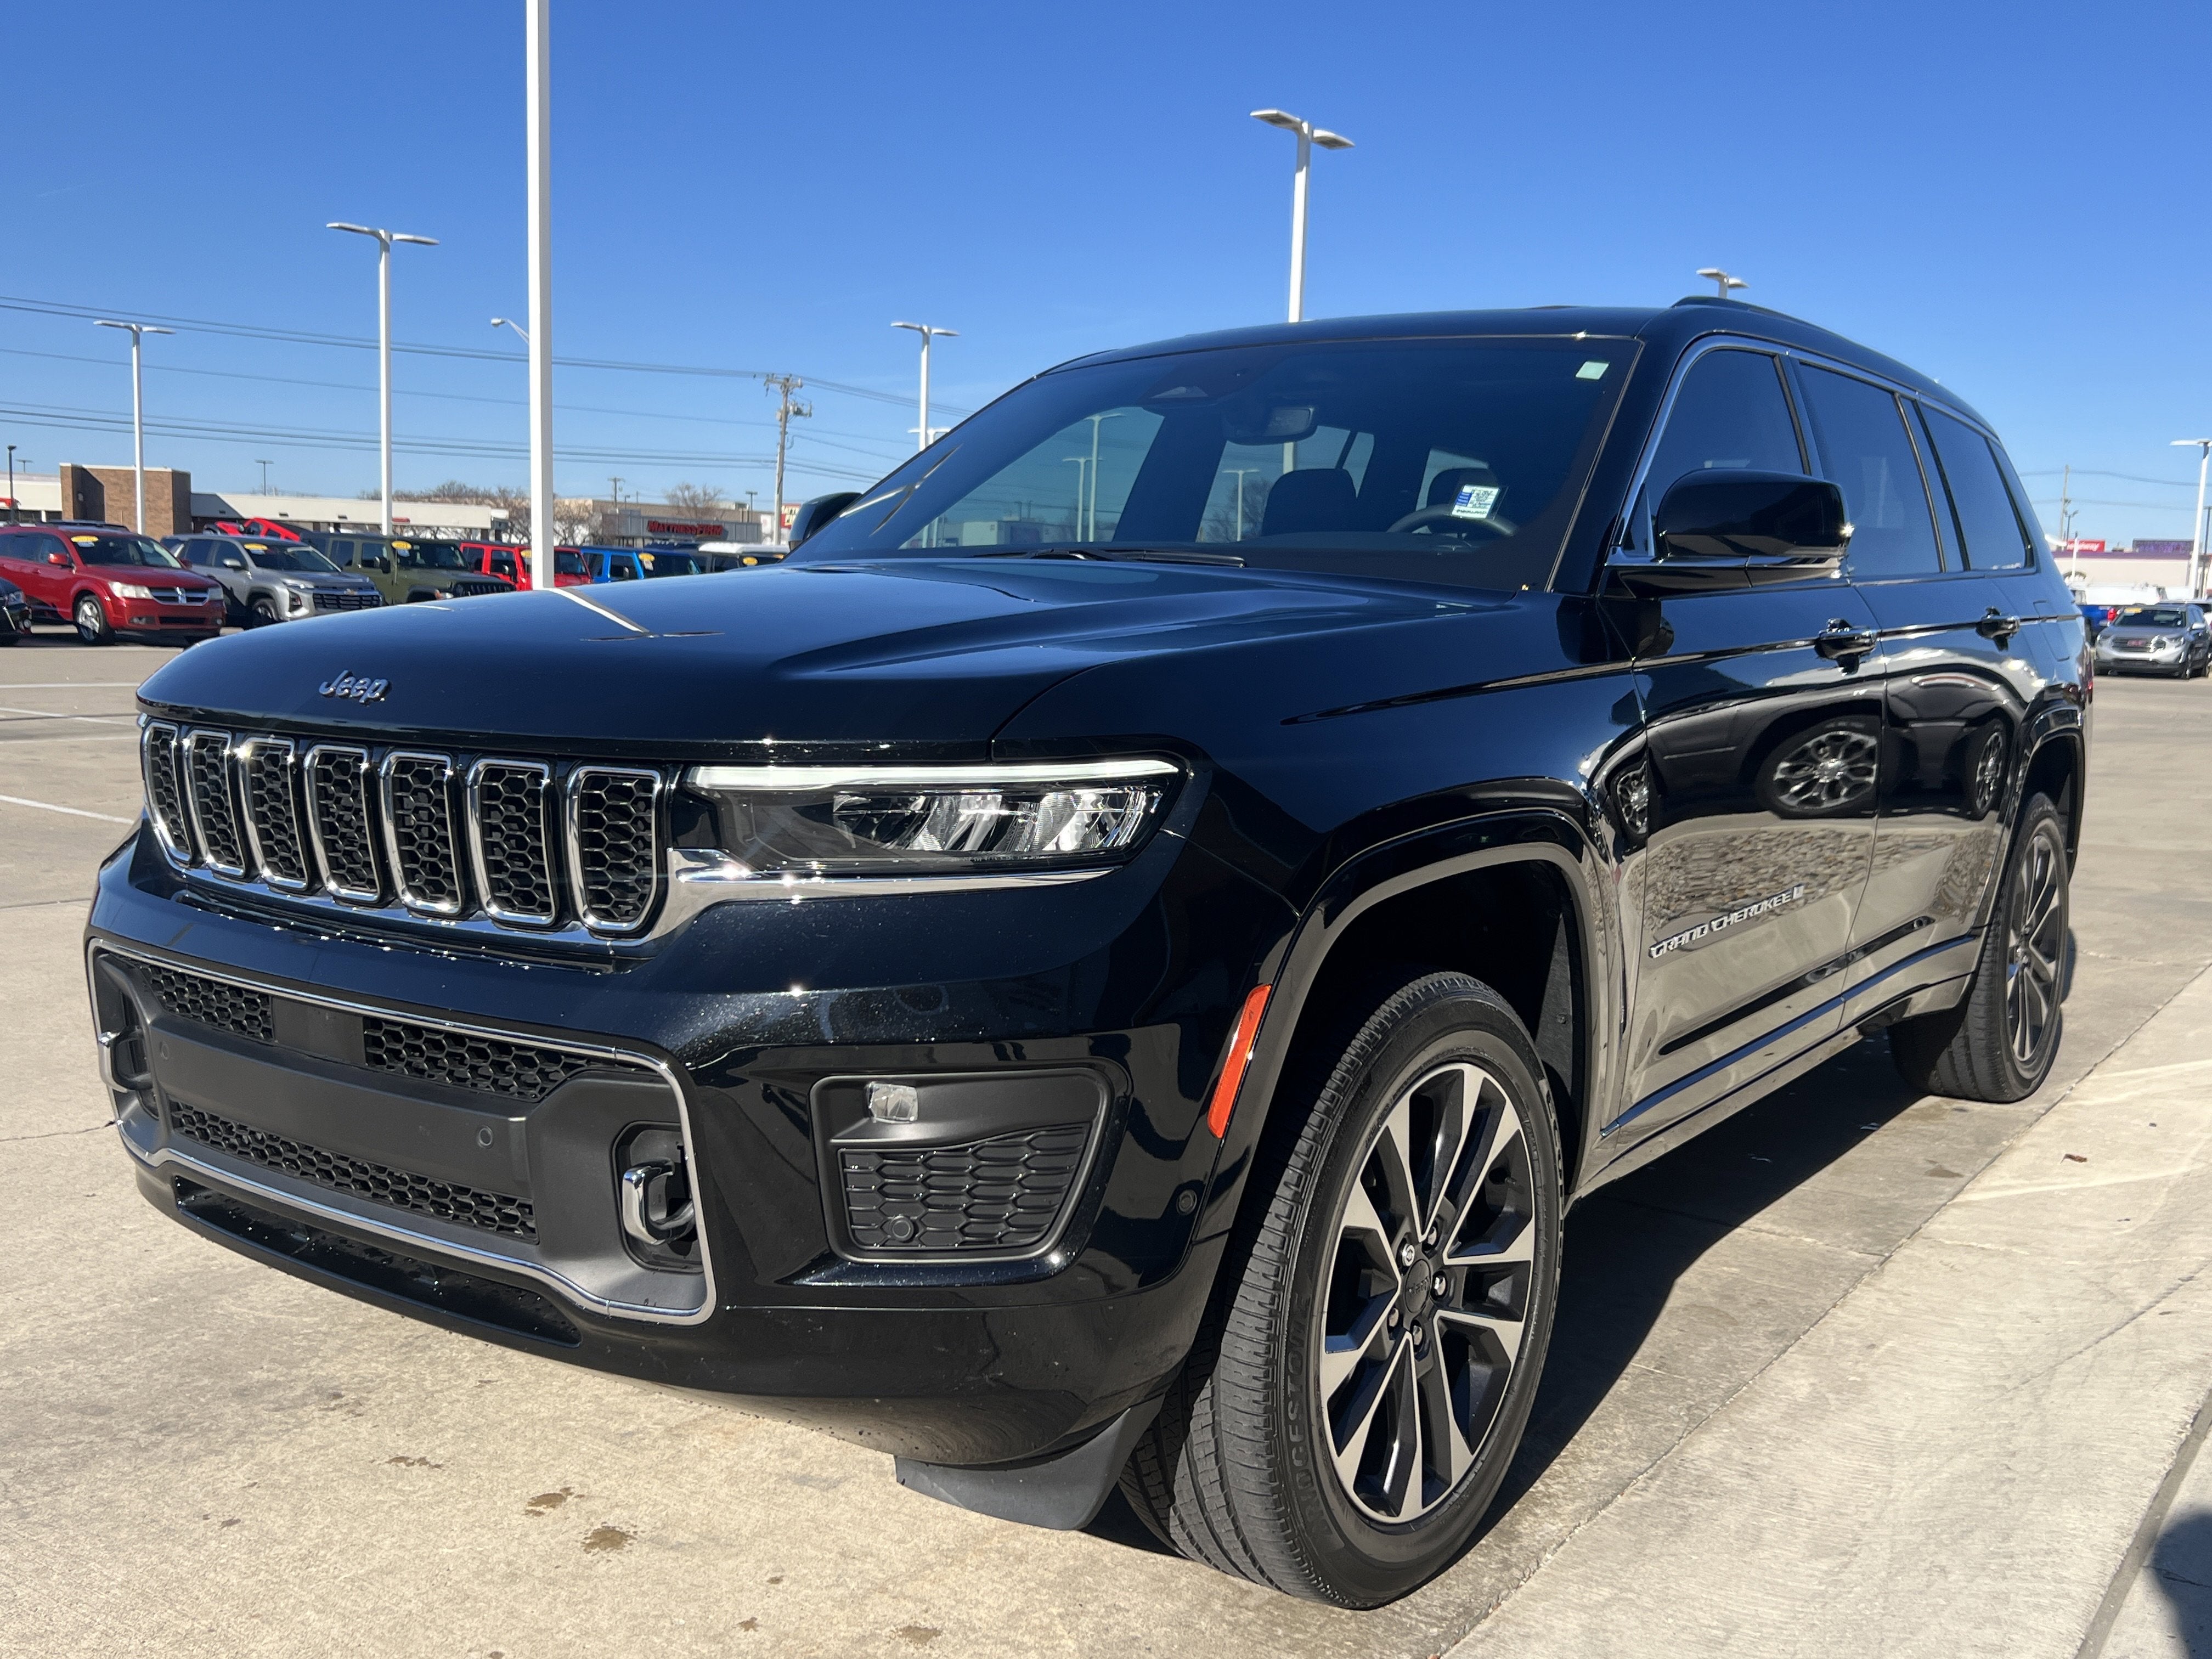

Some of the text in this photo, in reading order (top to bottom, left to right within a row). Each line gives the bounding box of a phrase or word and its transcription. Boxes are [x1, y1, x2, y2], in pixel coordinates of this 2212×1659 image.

[319, 669, 388, 703] Jeep
[1650, 923, 1708, 958] GRAND
[1709, 888, 1792, 932] CHEROKEE
